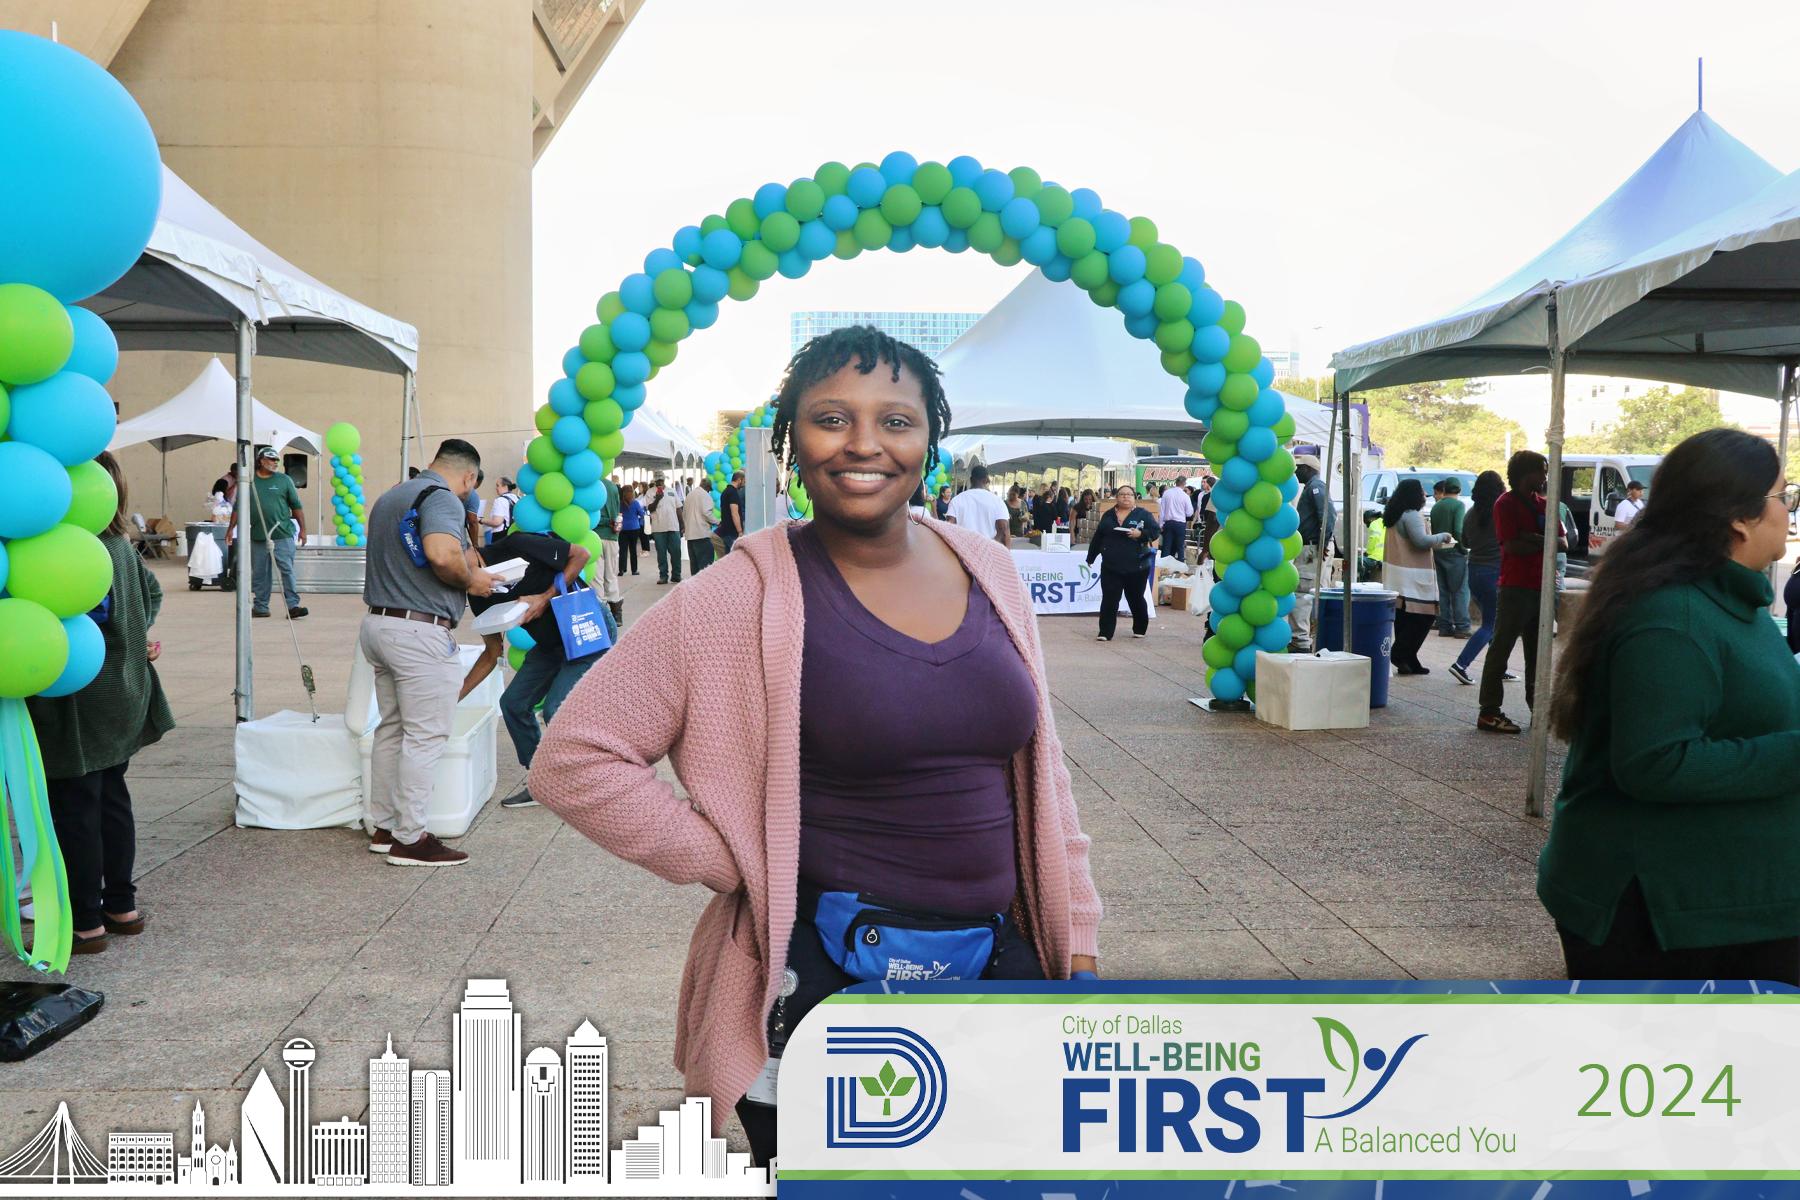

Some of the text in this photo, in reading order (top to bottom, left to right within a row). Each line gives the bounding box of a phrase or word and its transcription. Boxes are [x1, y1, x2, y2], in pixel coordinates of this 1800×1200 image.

[1019, 573, 1064, 582] LL-BEING
[1026, 582, 1081, 603] RST
[886, 970, 932, 980] FIRST
